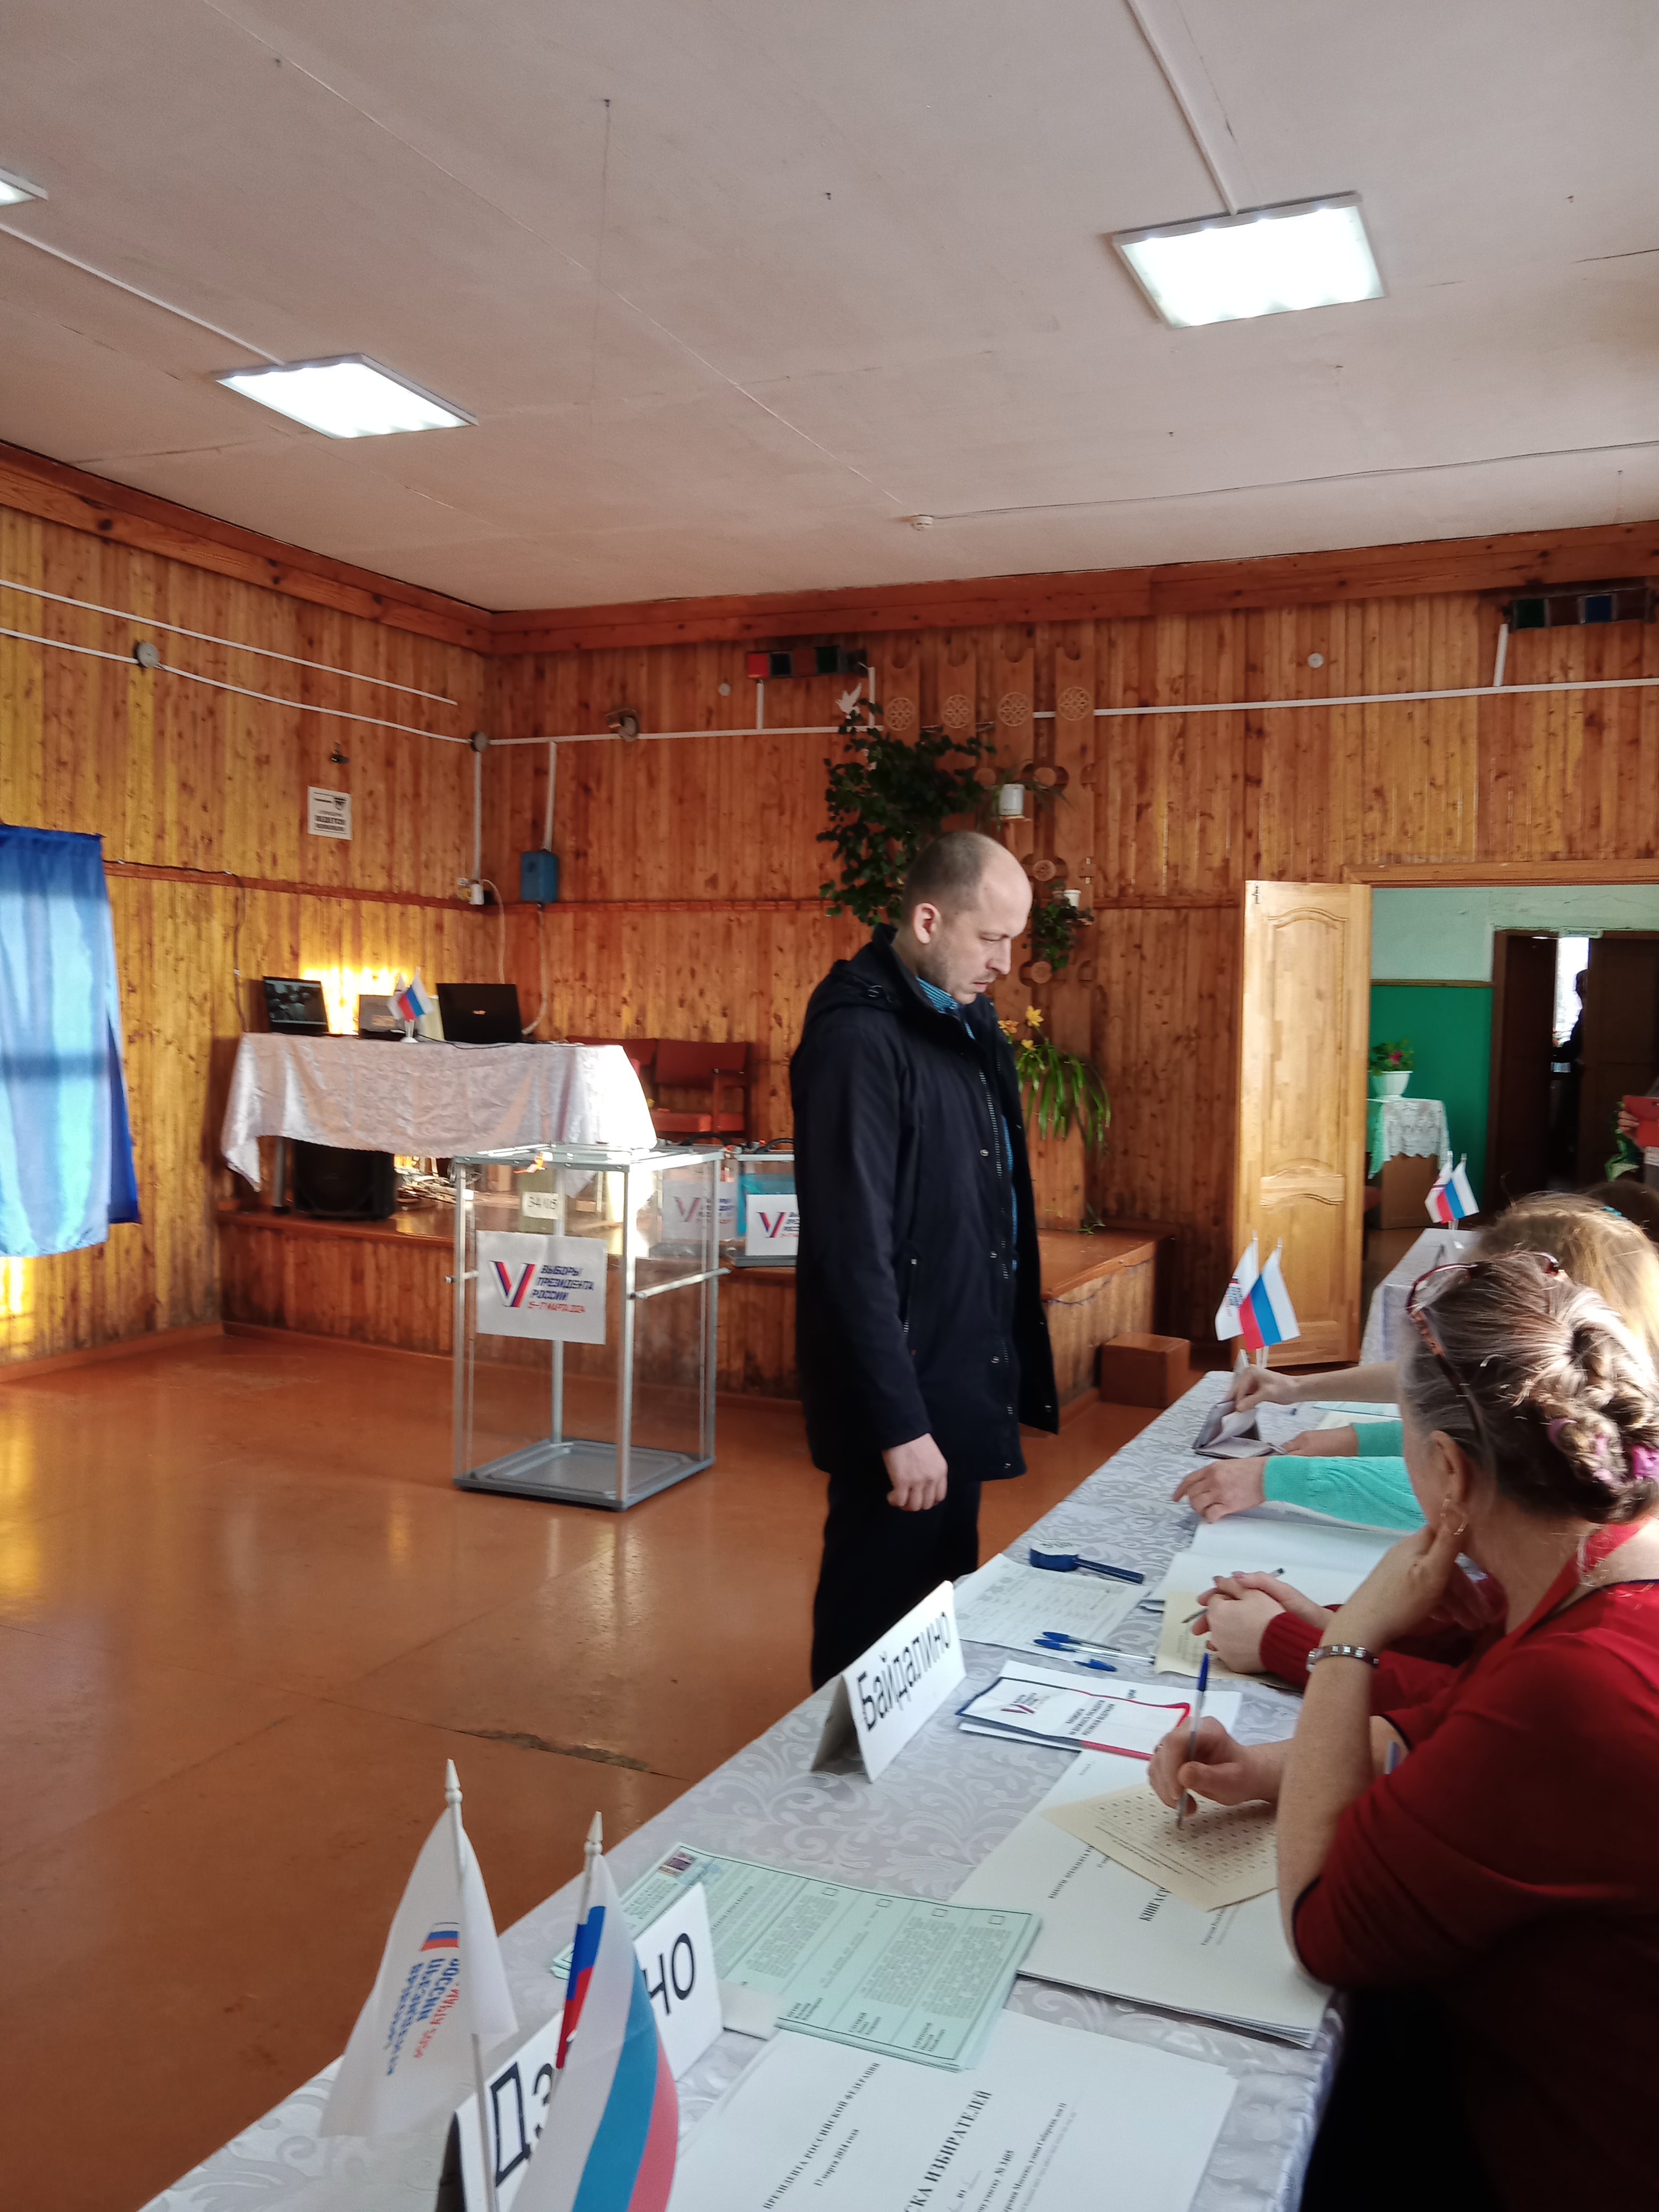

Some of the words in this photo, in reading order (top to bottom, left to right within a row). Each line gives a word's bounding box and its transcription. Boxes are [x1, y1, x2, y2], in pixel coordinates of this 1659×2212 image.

[540, 1264, 583, 1276] ВЫБОРЫ
[535, 1277, 595, 1291] ПРЕЗИДЕНТА
[530, 1289, 569, 1301] РОССИИ
[803, 2100, 849, 2160] РОССИЙСКОЙ
[924, 2090, 993, 2183] ИЗБИРАТЕЛЕЙ
